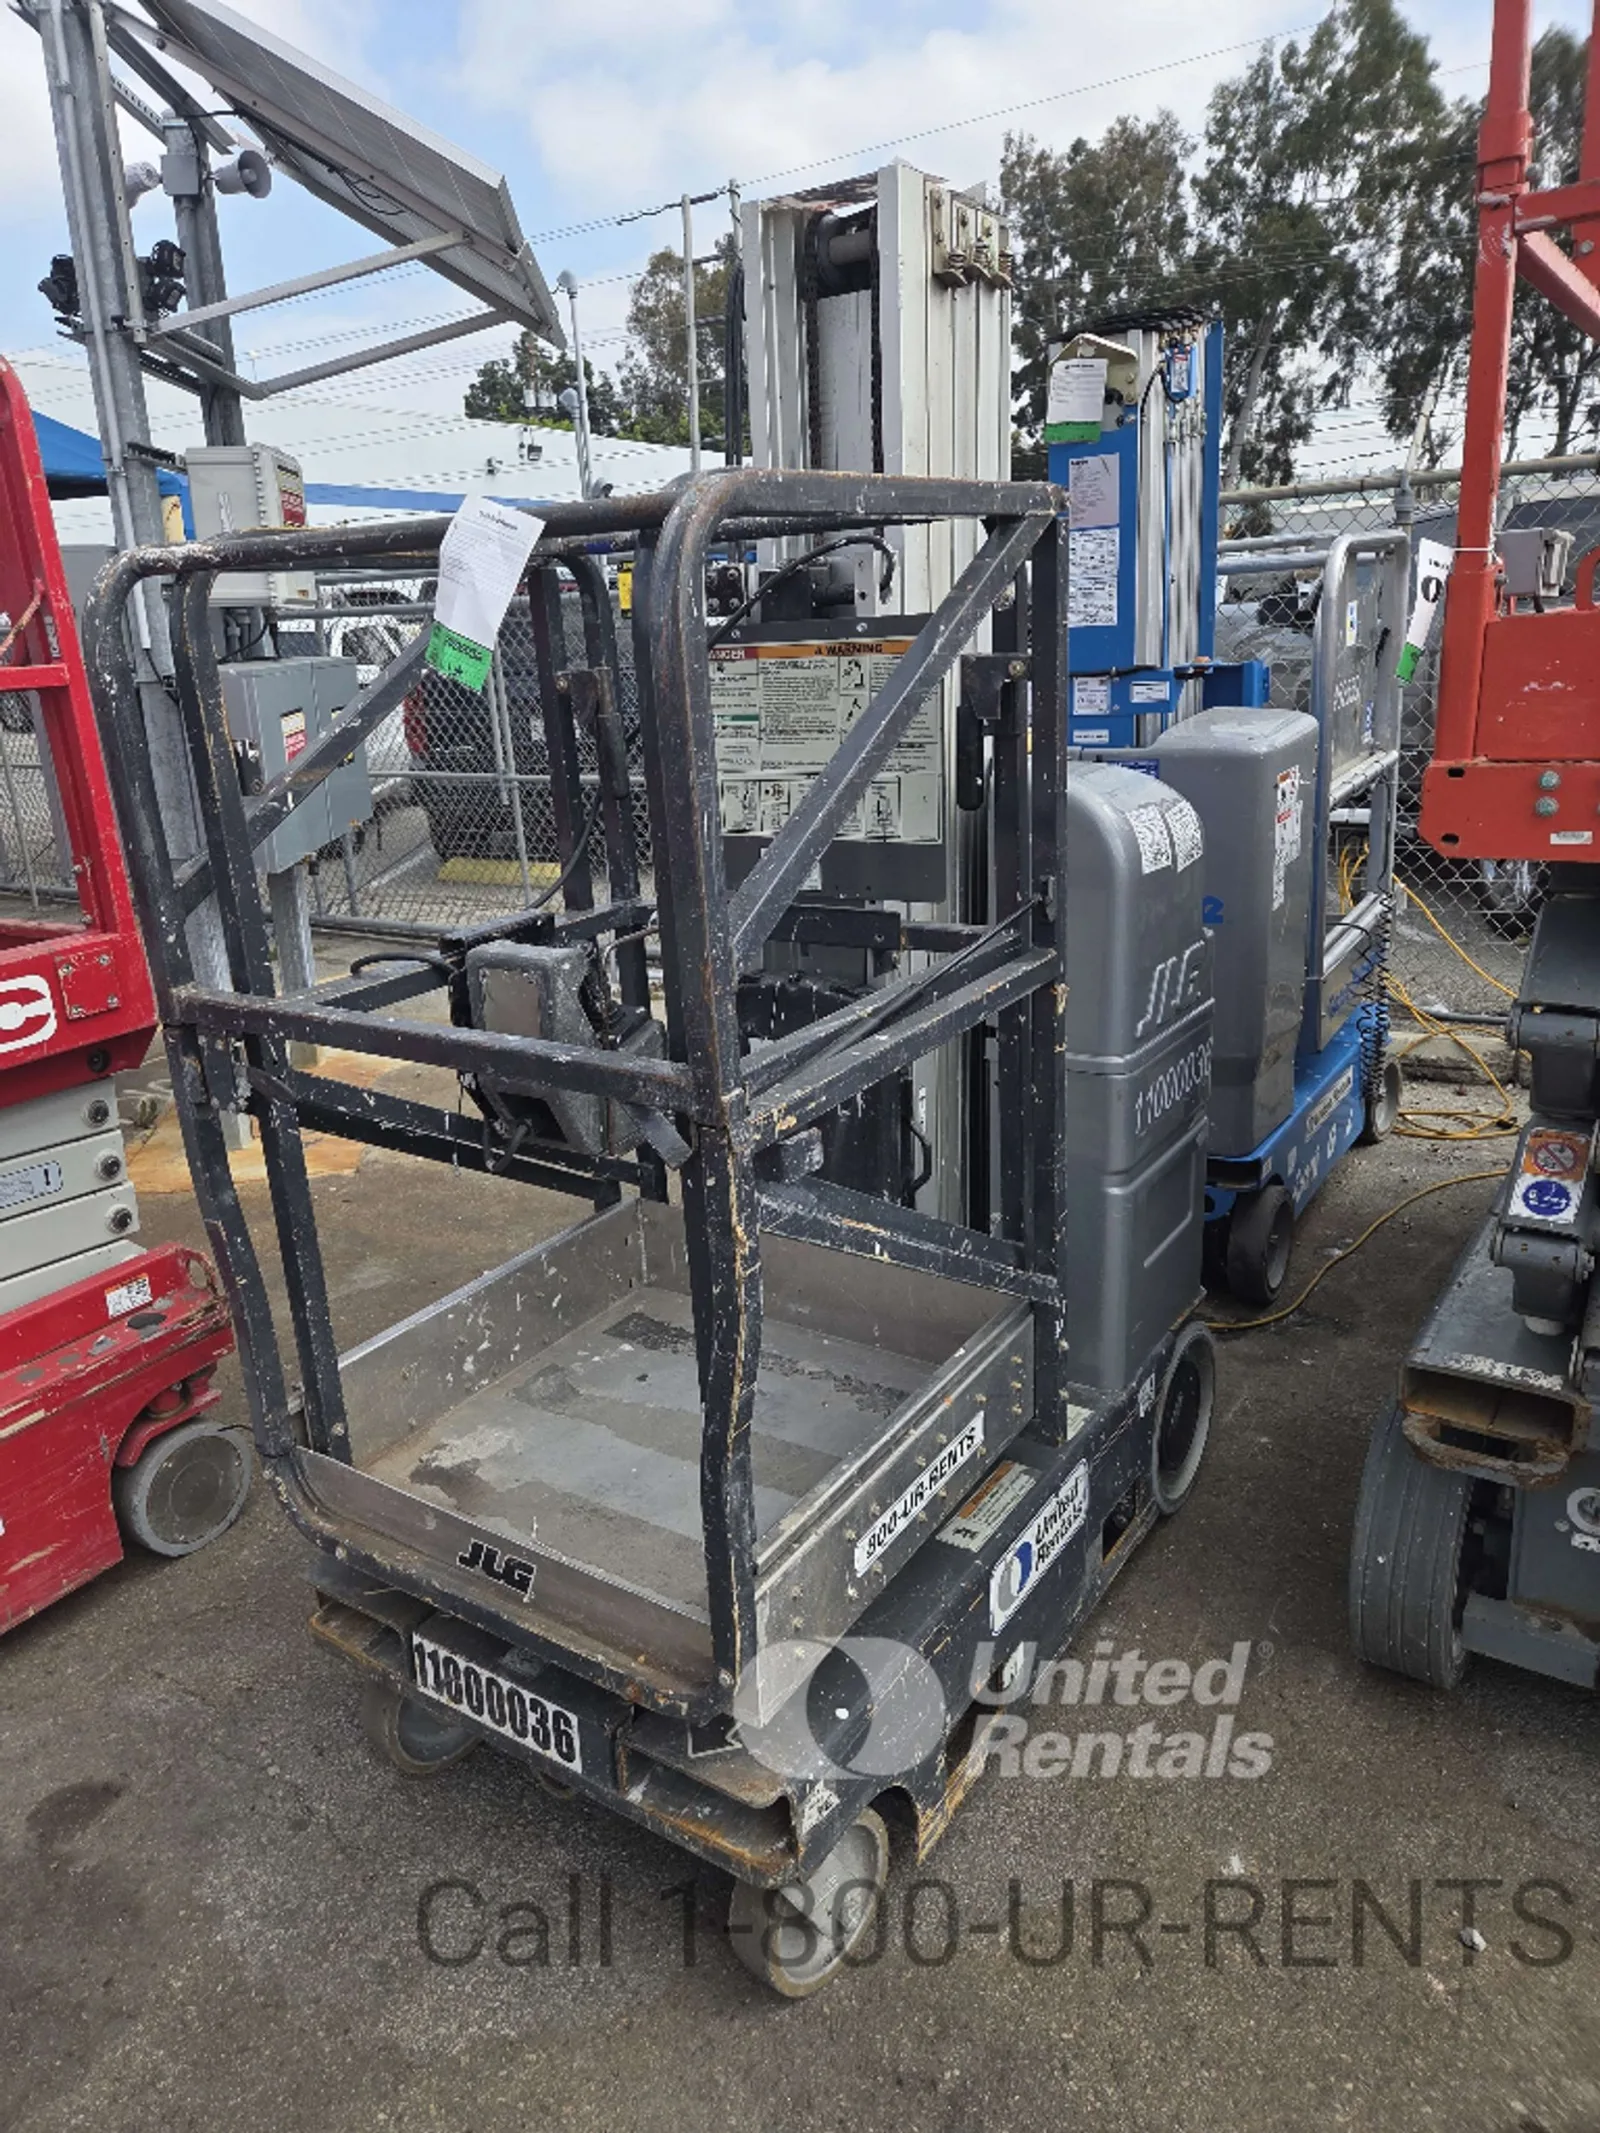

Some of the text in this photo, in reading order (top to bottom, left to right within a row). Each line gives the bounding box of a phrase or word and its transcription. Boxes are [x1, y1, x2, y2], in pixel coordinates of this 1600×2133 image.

[707, 650, 746, 660] ANGER
[826, 643, 883, 656] WARNING
[866, 1426, 976, 1559] 800-UR-RENTS
[457, 1539, 536, 1597] JLG
